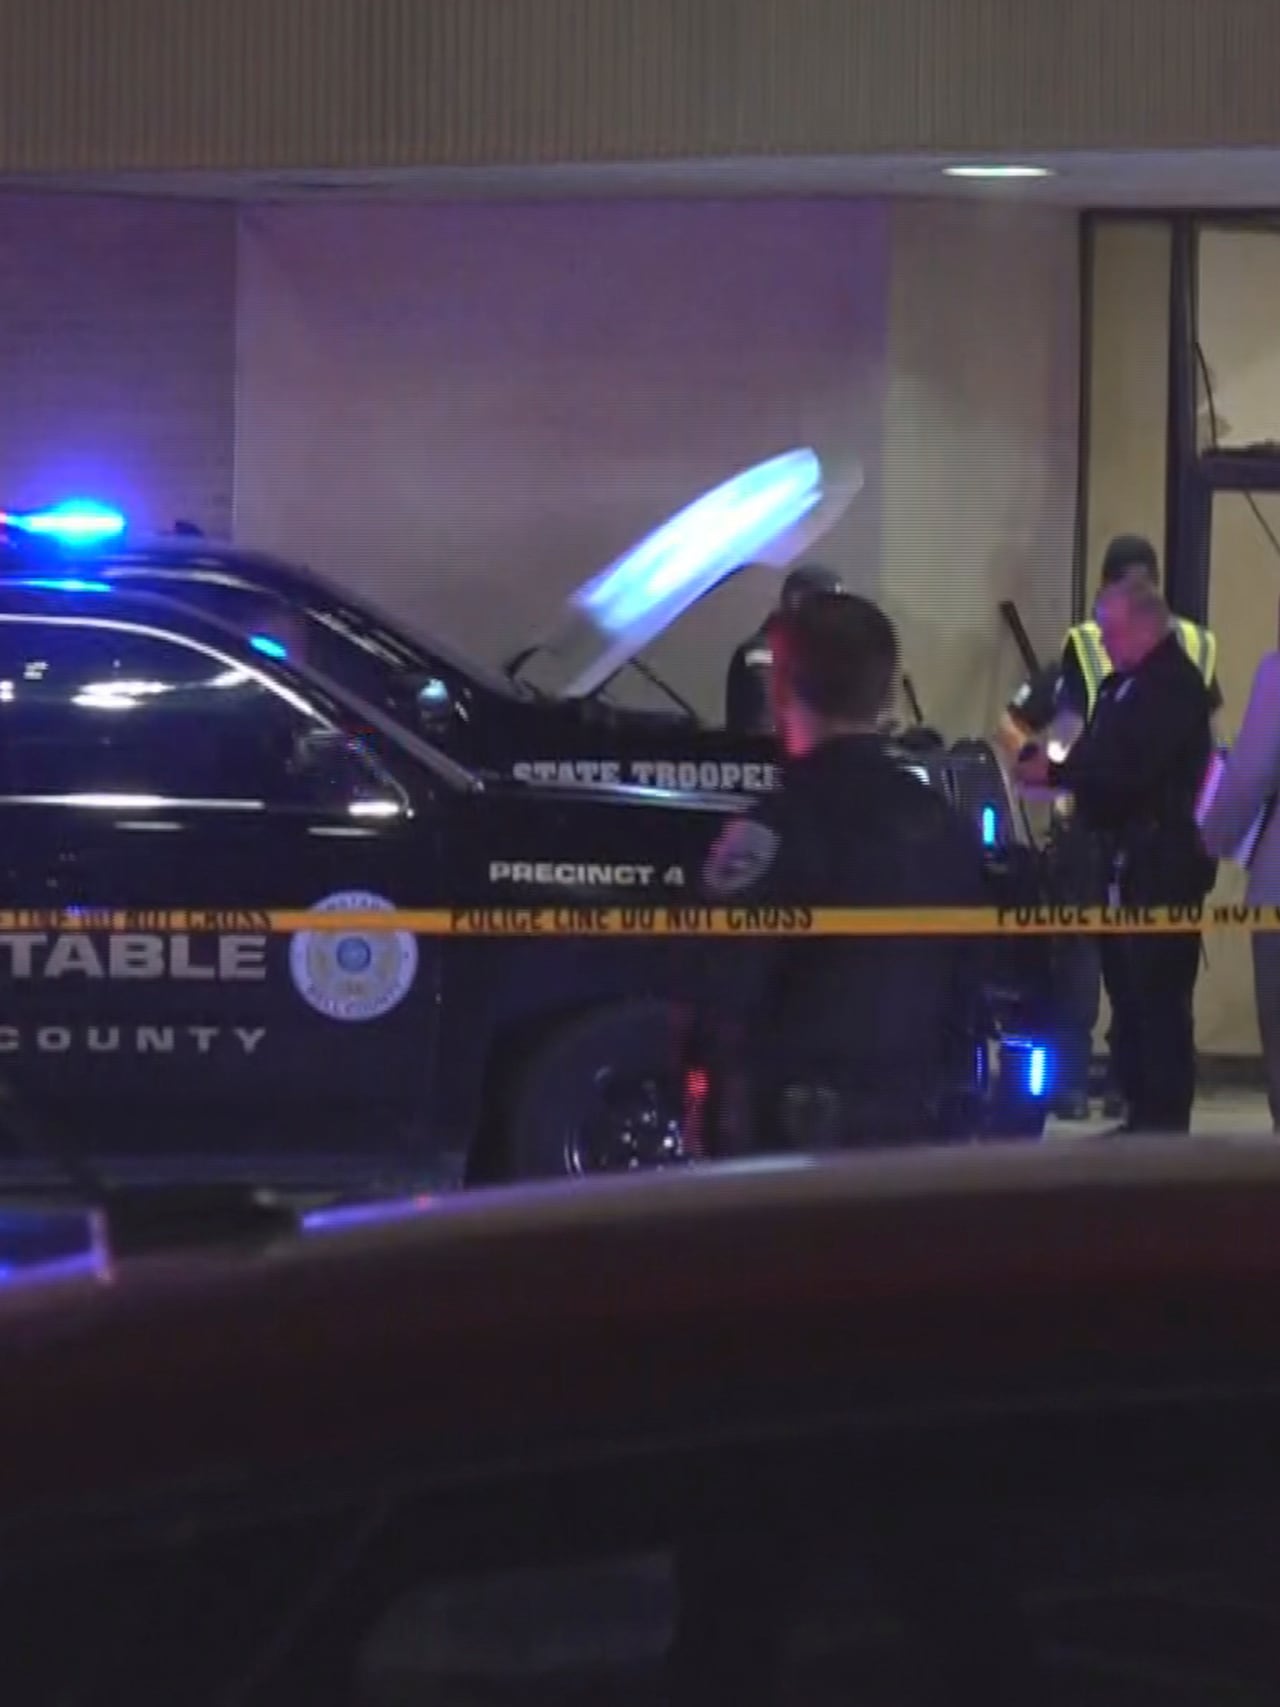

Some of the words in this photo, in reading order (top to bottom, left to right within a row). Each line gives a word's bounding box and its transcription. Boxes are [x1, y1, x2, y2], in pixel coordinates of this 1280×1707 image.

[513, 762, 619, 786] STATE
[490, 862, 654, 884] PRECINCT
[664, 868, 685, 885] 4
[553, 908, 609, 931] LINE
[621, 908, 653, 930] DO
[667, 907, 714, 930] NOT
